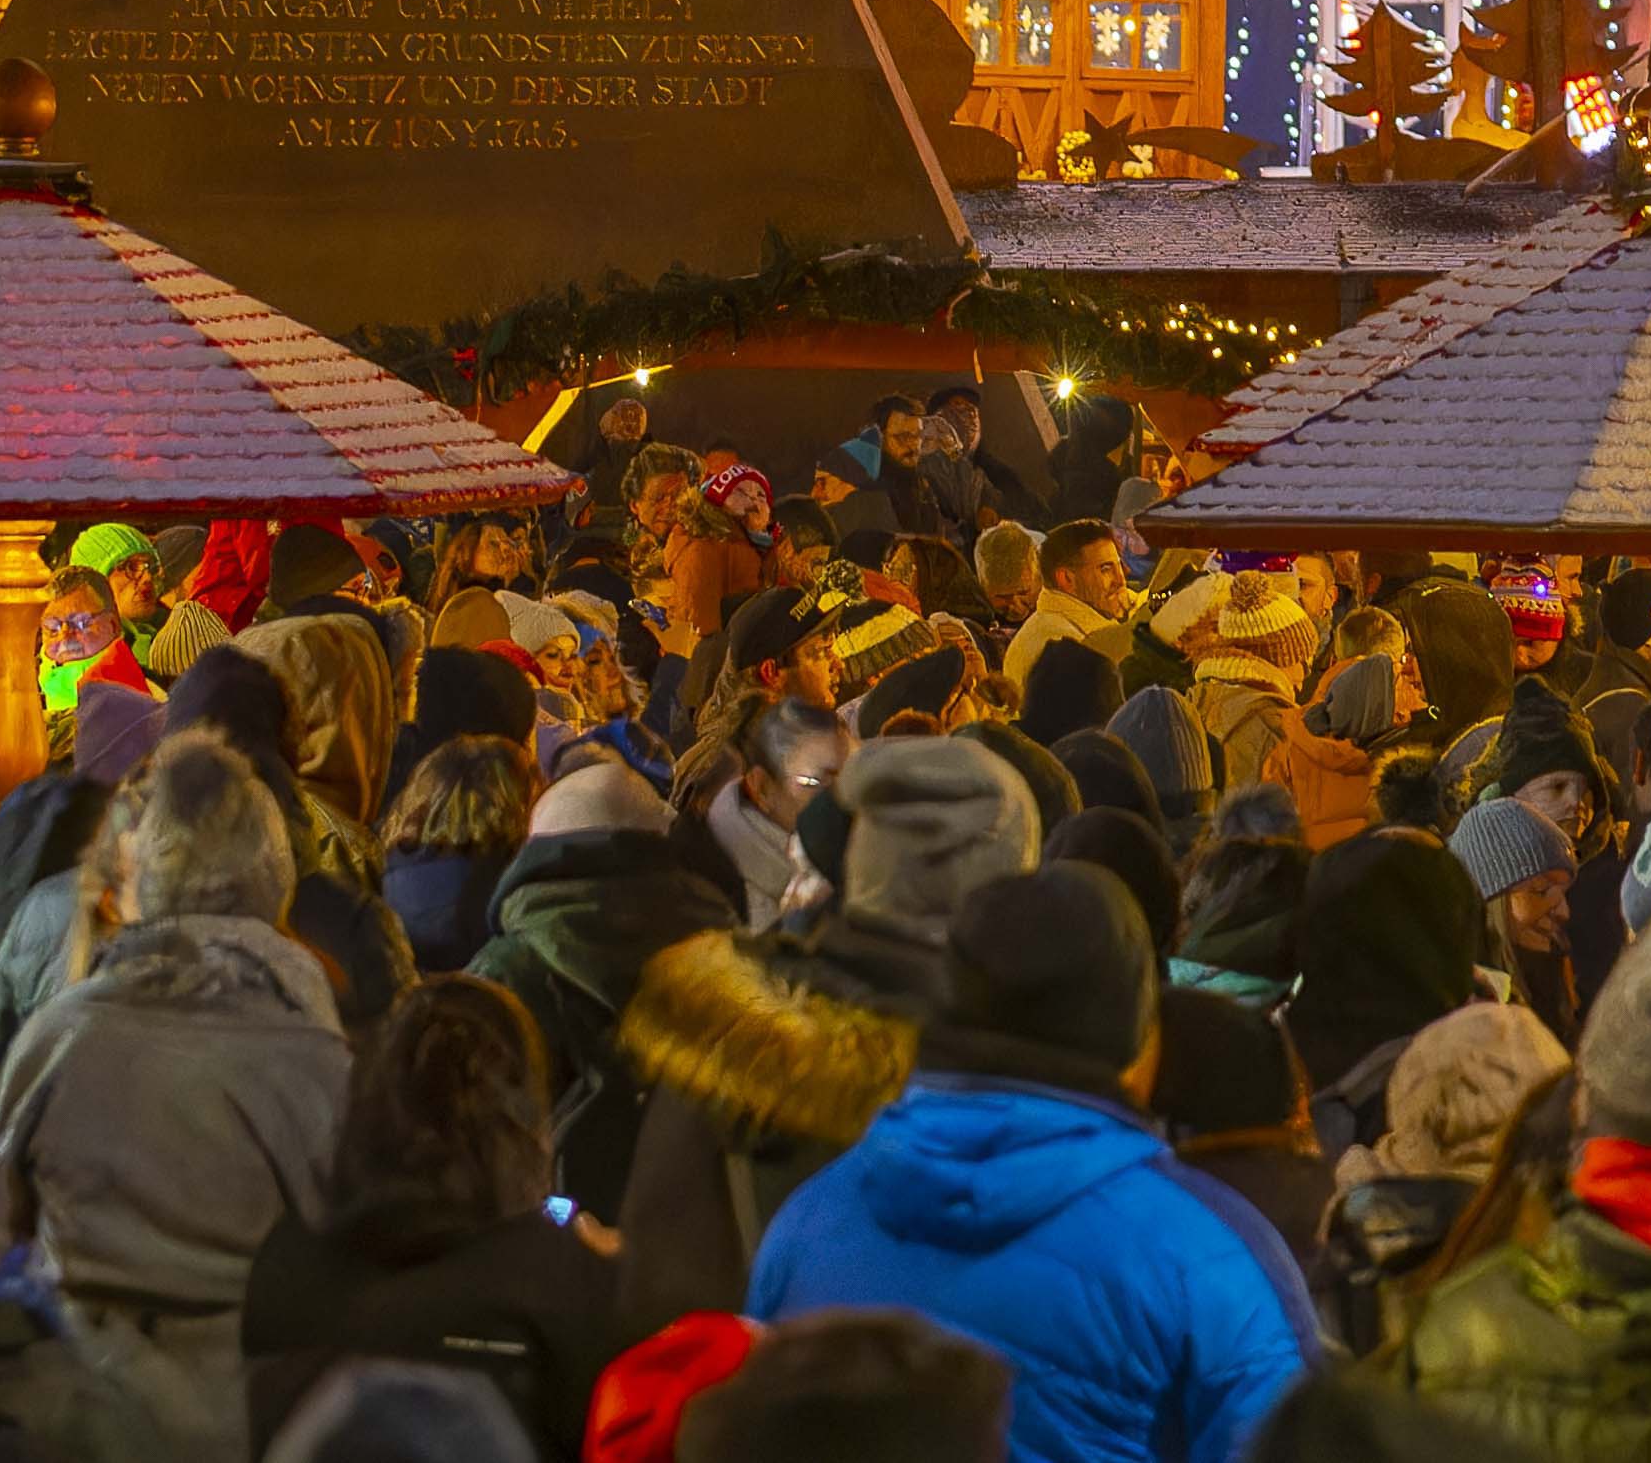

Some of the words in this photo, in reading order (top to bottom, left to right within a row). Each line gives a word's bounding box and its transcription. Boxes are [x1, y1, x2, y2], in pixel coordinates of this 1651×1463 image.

[168, 31, 239, 61] DEN
[249, 31, 390, 62] ERSTEN
[400, 32, 636, 64] GRUNDSTEIN
[640, 33, 686, 64] ZU
[693, 33, 816, 65] SEINEM
[86, 73, 208, 104] NEUEN
[220, 73, 406, 104] WOHNSITZ
[416, 74, 497, 105] UND
[508, 74, 639, 105] DIESER
[651, 75, 774, 106] STADT
